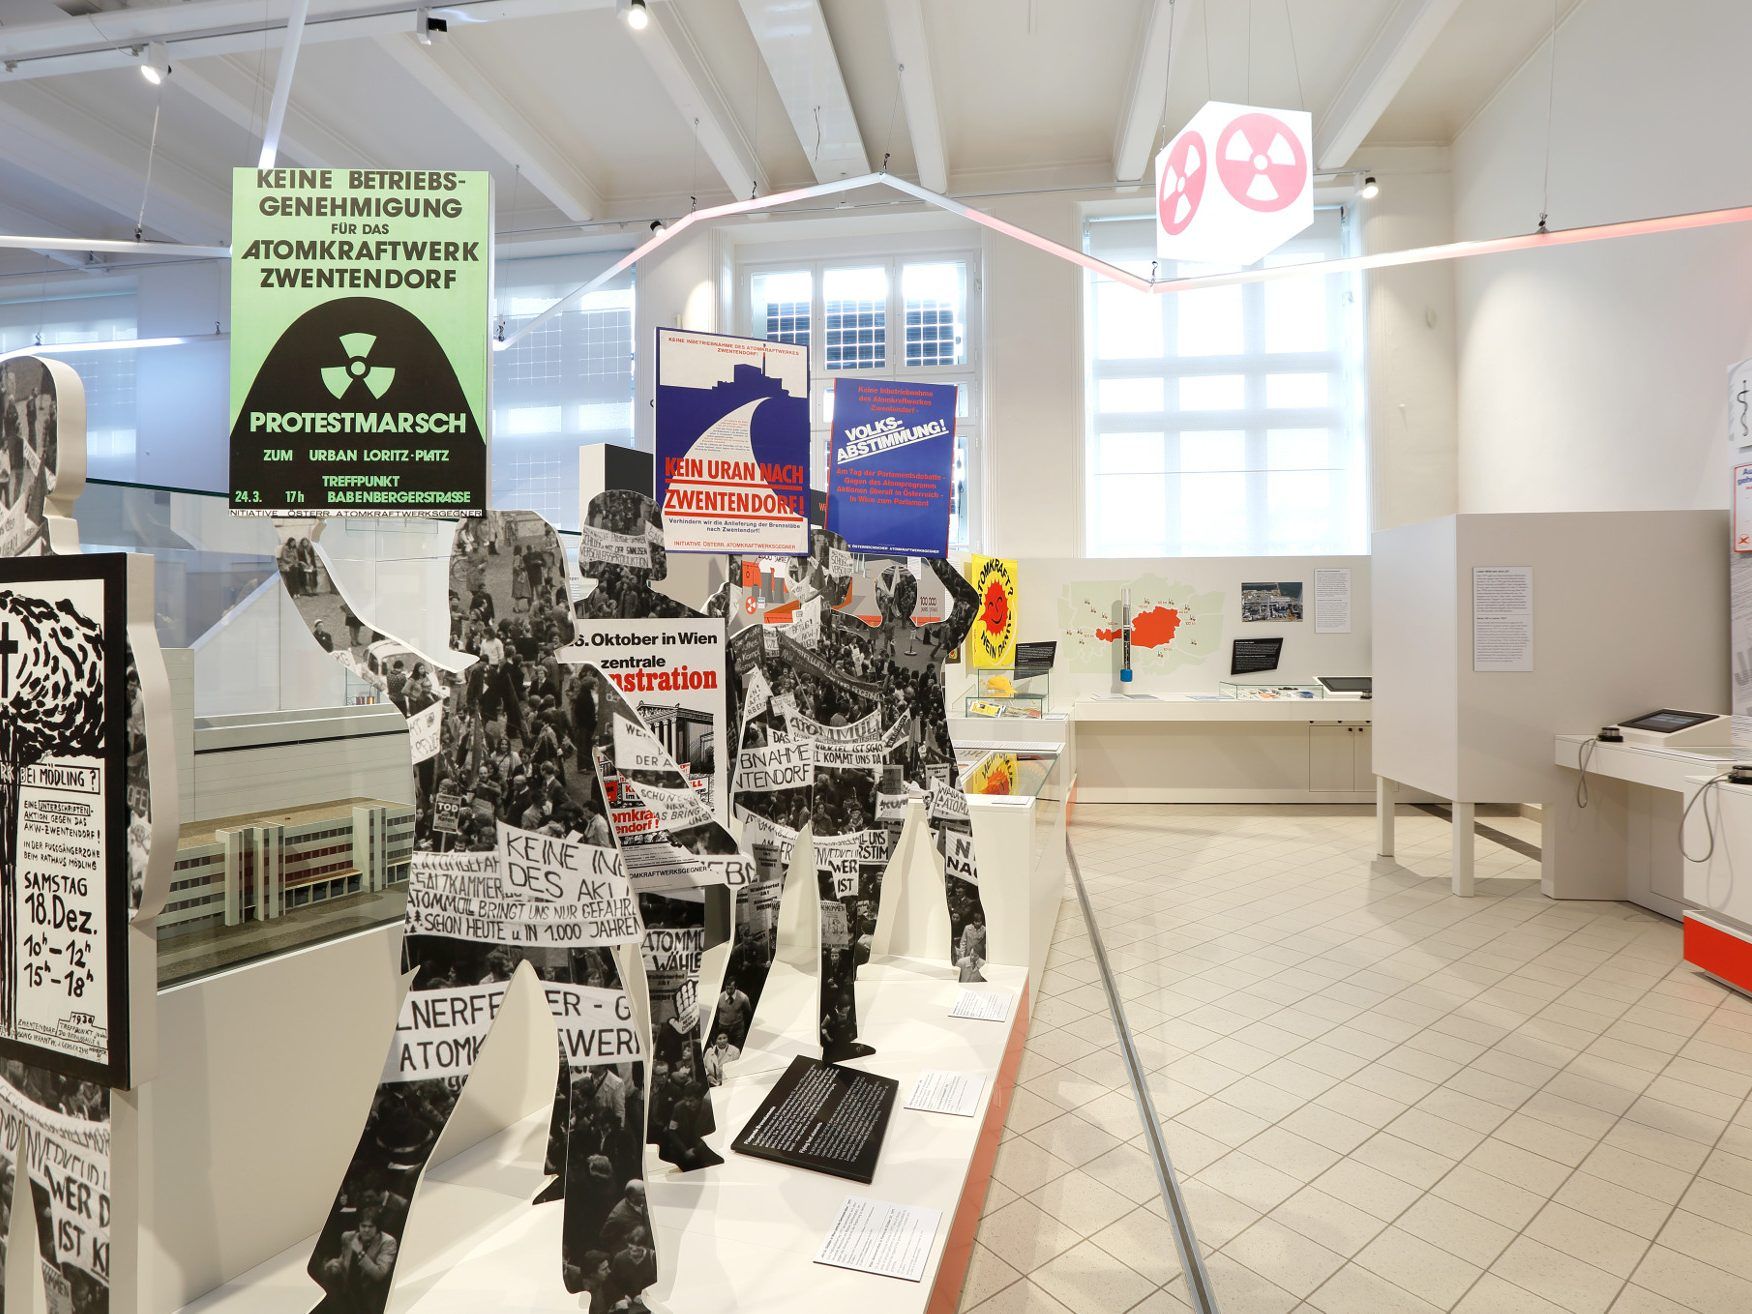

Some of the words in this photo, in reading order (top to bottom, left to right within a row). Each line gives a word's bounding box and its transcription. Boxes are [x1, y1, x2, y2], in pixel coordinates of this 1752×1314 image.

[257, 169, 332, 189] KEINE
[349, 170, 466, 191] BETRIEBS-
[259, 196, 462, 218] GENEHMIGUNG
[331, 221, 357, 235] FÜR
[362, 223, 389, 235] DAS
[241, 239, 479, 262] ATOMKRAFTWERK
[260, 268, 456, 289] ZWENTENDORF
[250, 411, 466, 434] PROTESTMARSCH
[844, 416, 904, 441] VOLKS-
[837, 418, 947, 462] ABSTIMMUNG!
[264, 450, 293, 461] ZUM
[309, 450, 357, 461] URBAN
[665, 456, 703, 478] KEIN
[708, 460, 756, 481] URAN
[759, 463, 804, 484] NACH
[322, 475, 400, 488] TREFFPUNKT
[235, 491, 263, 503] 24.3.
[327, 491, 471, 503] BABENBERGERSTRASSE
[664, 488, 805, 515] ZWENTENDORF!
[336, 510, 483, 518] ATOMKRAFTWERKSGEGNER
[591, 633, 659, 647] Oktober
[662, 632, 676, 646] in
[678, 632, 718, 645] Wien
[601, 655, 666, 669] zentrale
[636, 755, 659, 766] DER
[20, 767, 36, 784] BEI
[40, 763, 85, 787] MÖDLING
[438, 802, 459, 813] TOD
[51, 814, 72, 824] GEGEN
[74, 817, 87, 827] DAS
[24, 851, 38, 860] BEIM
[41, 853, 67, 867] RATHAUS
[69, 858, 97, 871] MÖDLING
[506, 832, 579, 872] KEINE
[828, 859, 858, 874] WER
[24, 871, 88, 896] SAMSTAG
[508, 862, 564, 899] DES
[837, 878, 855, 893] IST
[479, 900, 526, 920] BRINGT
[528, 905, 549, 920] UNS
[554, 904, 578, 920] NUR
[424, 913, 461, 935] SCHON
[466, 918, 506, 940] HEUTE
[525, 925, 538, 942] IN
[544, 924, 582, 941] 1.000
[44, 1165, 92, 1219] WER
[59, 1219, 86, 1258] IST
